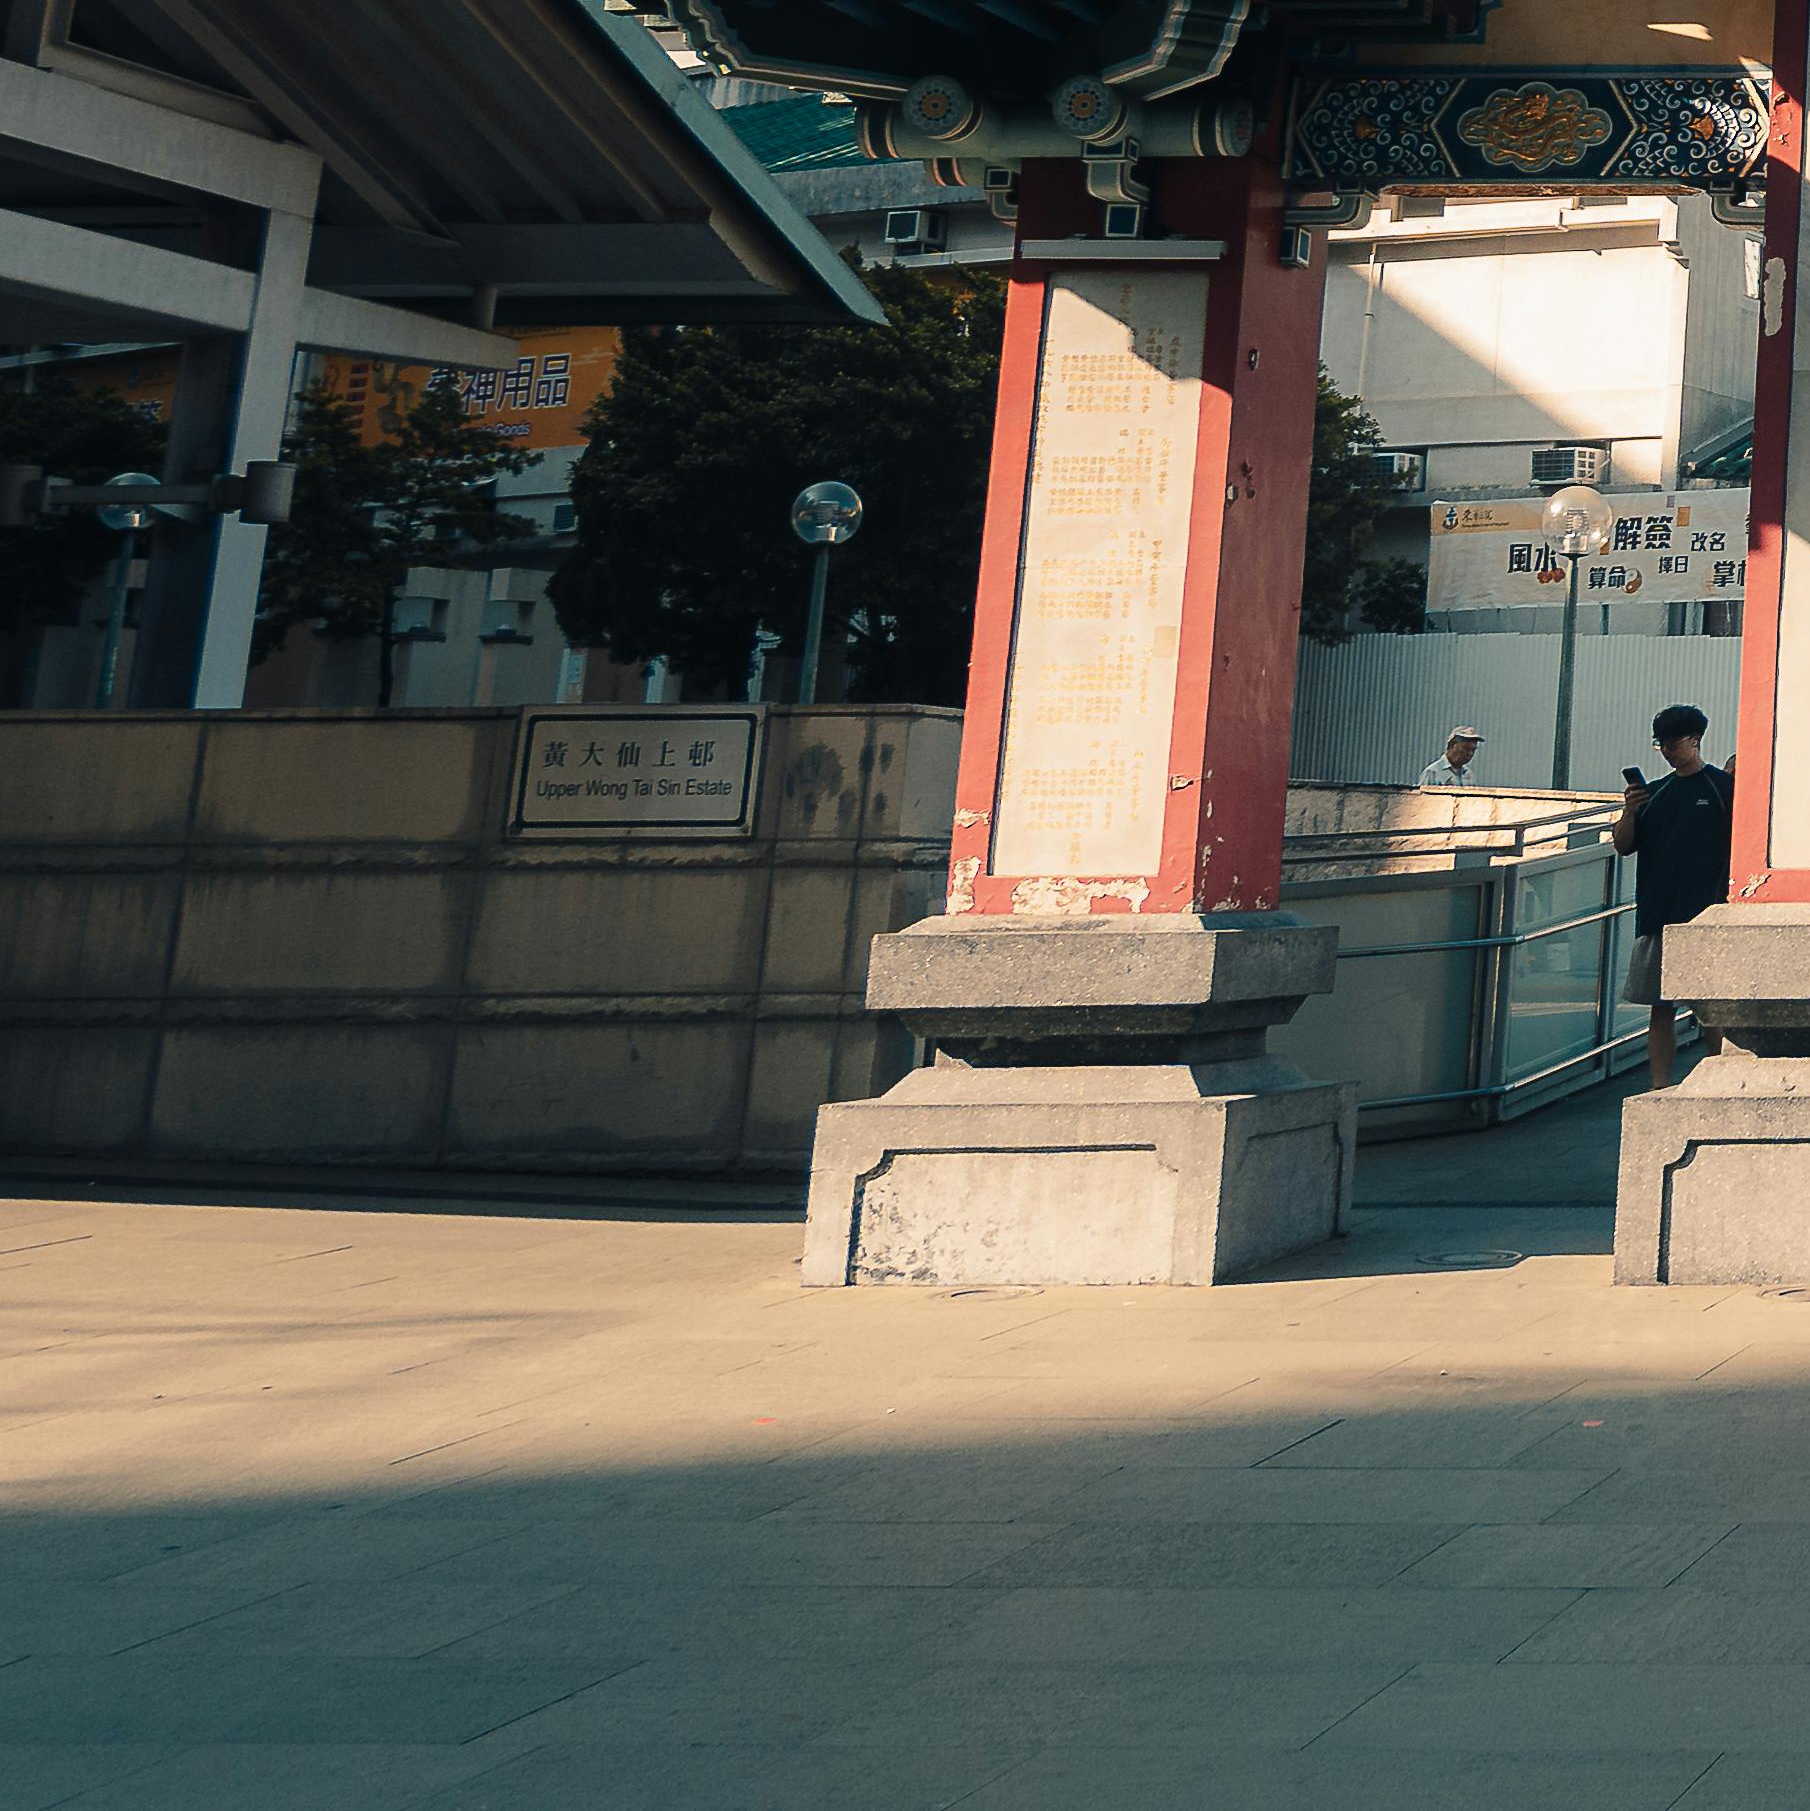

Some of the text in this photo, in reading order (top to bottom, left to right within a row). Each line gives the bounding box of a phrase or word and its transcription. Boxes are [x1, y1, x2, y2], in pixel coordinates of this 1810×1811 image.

[1690, 531, 1727, 553] 改名
[1507, 541, 1557, 575] 風水
[1657, 554, 1690, 575] 擇日
[1587, 564, 1627, 590] 算命
[542, 740, 716, 769] 黃大仙上邨
[536, 777, 732, 800] Upper Wong Tai Sin Estate
